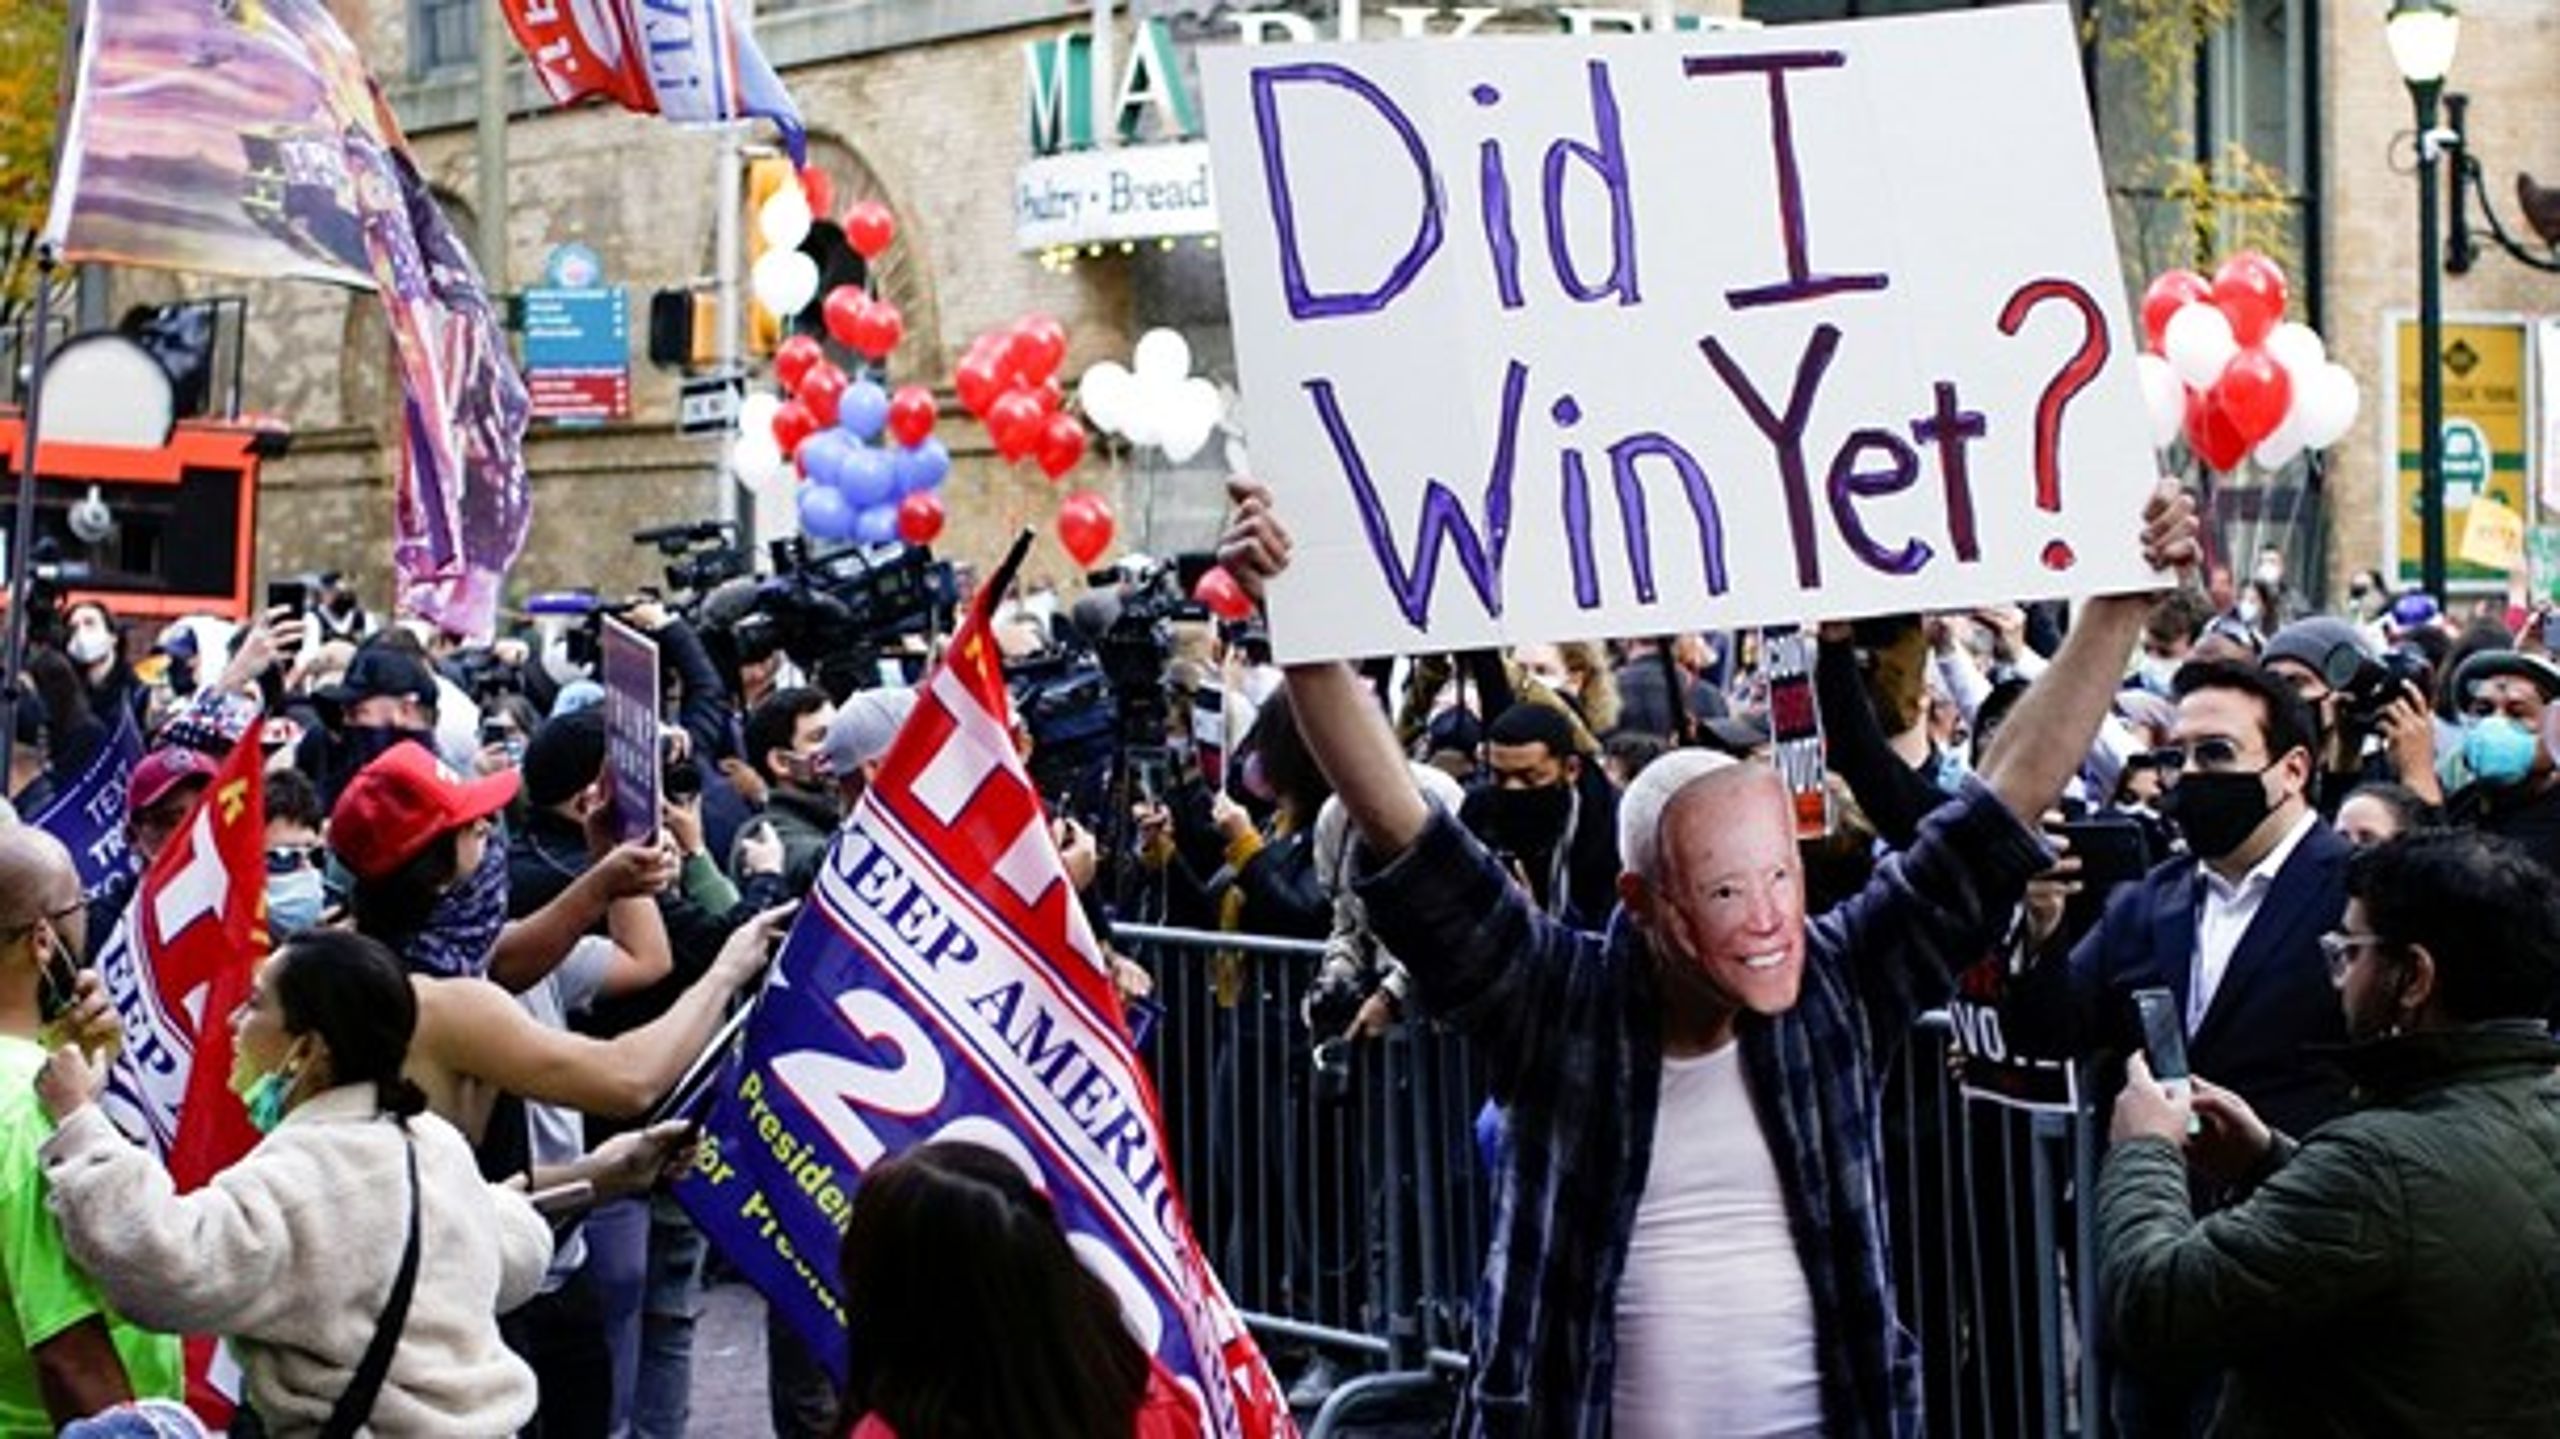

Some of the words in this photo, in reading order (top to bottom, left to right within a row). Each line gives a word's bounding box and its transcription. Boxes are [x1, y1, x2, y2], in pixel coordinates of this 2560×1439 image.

[1250, 60, 1642, 321] Did
[1682, 50, 1890, 311] I
[1300, 359, 1729, 633] Win
